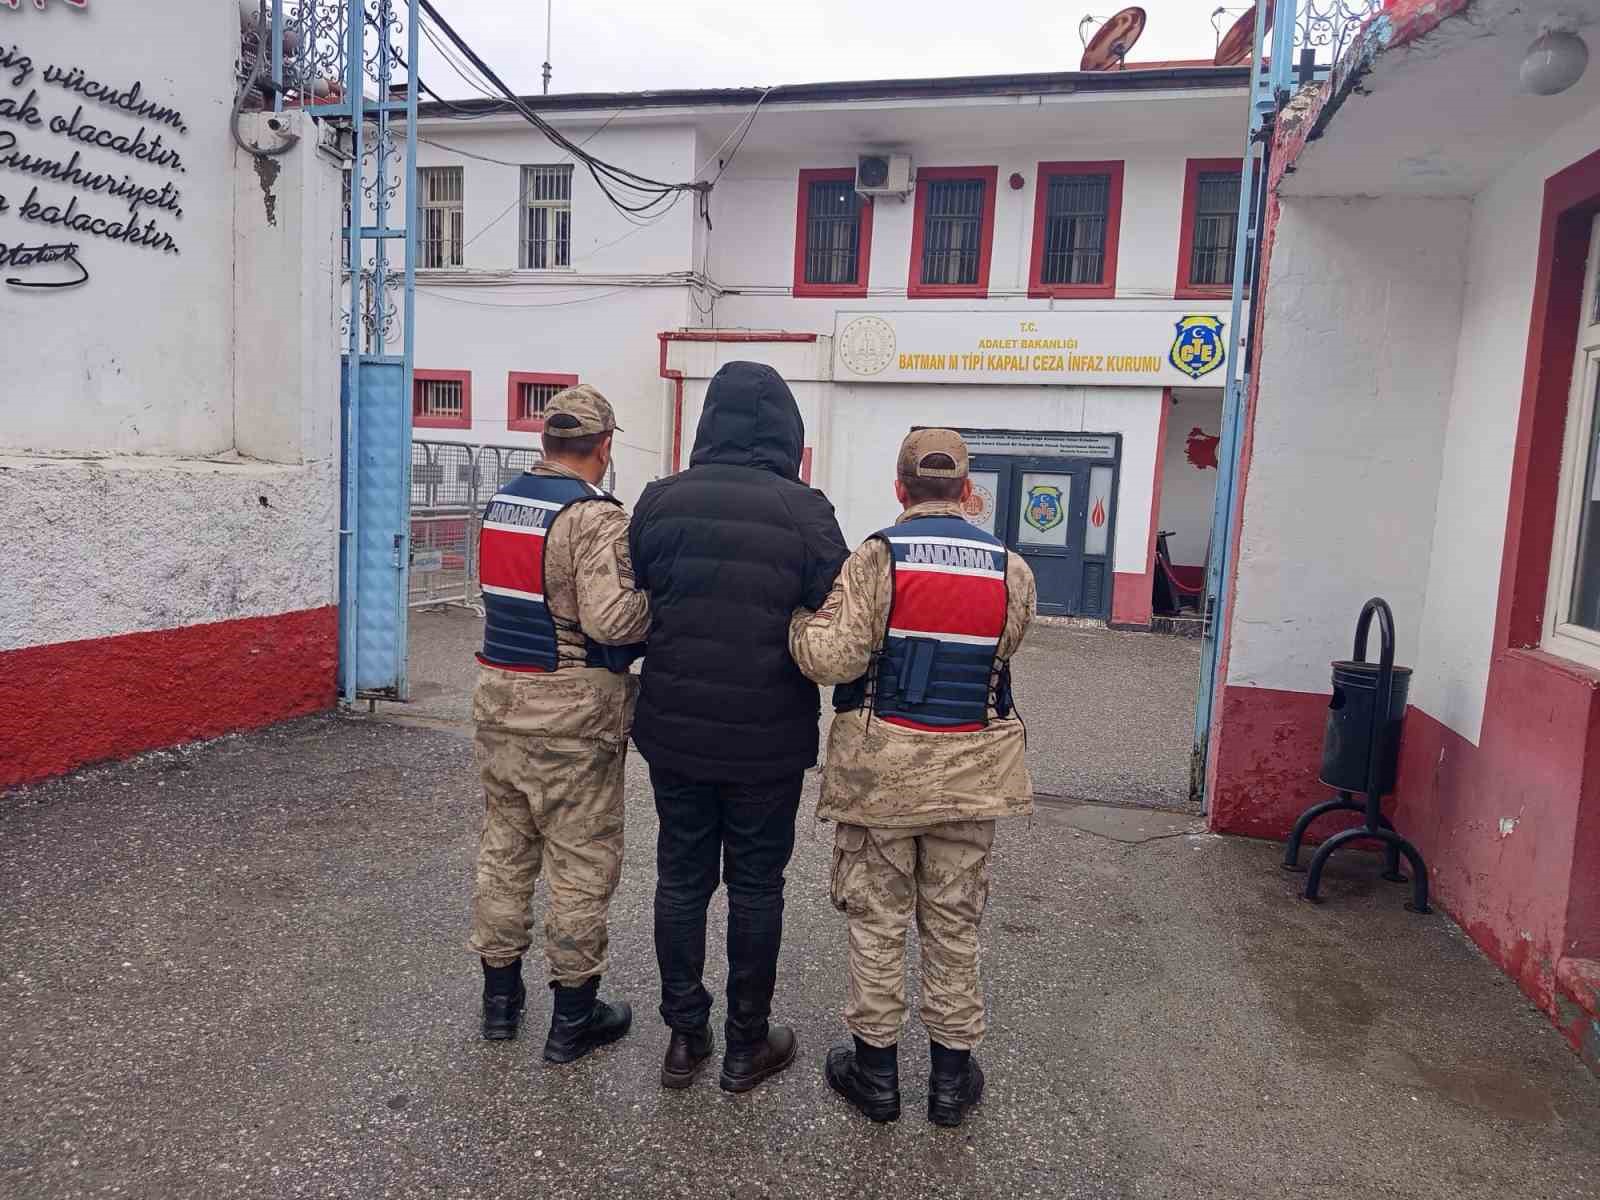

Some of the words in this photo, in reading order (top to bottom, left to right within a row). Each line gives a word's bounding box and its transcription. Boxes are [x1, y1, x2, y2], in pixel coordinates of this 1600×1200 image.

[0, 45, 34, 85] iz
[43, 64, 188, 134] vücudum,
[49, 105, 186, 173] olacaktır.
[19, 186, 179, 253] kalacaktır.
[1020, 322, 1038, 333] T.C.
[979, 339, 1018, 349] ADALET
[1021, 338, 1078, 349] BAKANLIĞI
[899, 353, 946, 370] BATMAN
[962, 352, 984, 370] TİPİ
[987, 354, 1029, 371] KAPALI
[1033, 354, 1064, 371] CEZA
[1068, 352, 1103, 371] İNFAZ
[1107, 355, 1161, 372] KURUMU
[488, 502, 546, 527] JANDARMA
[905, 543, 995, 570] JANDARMA
